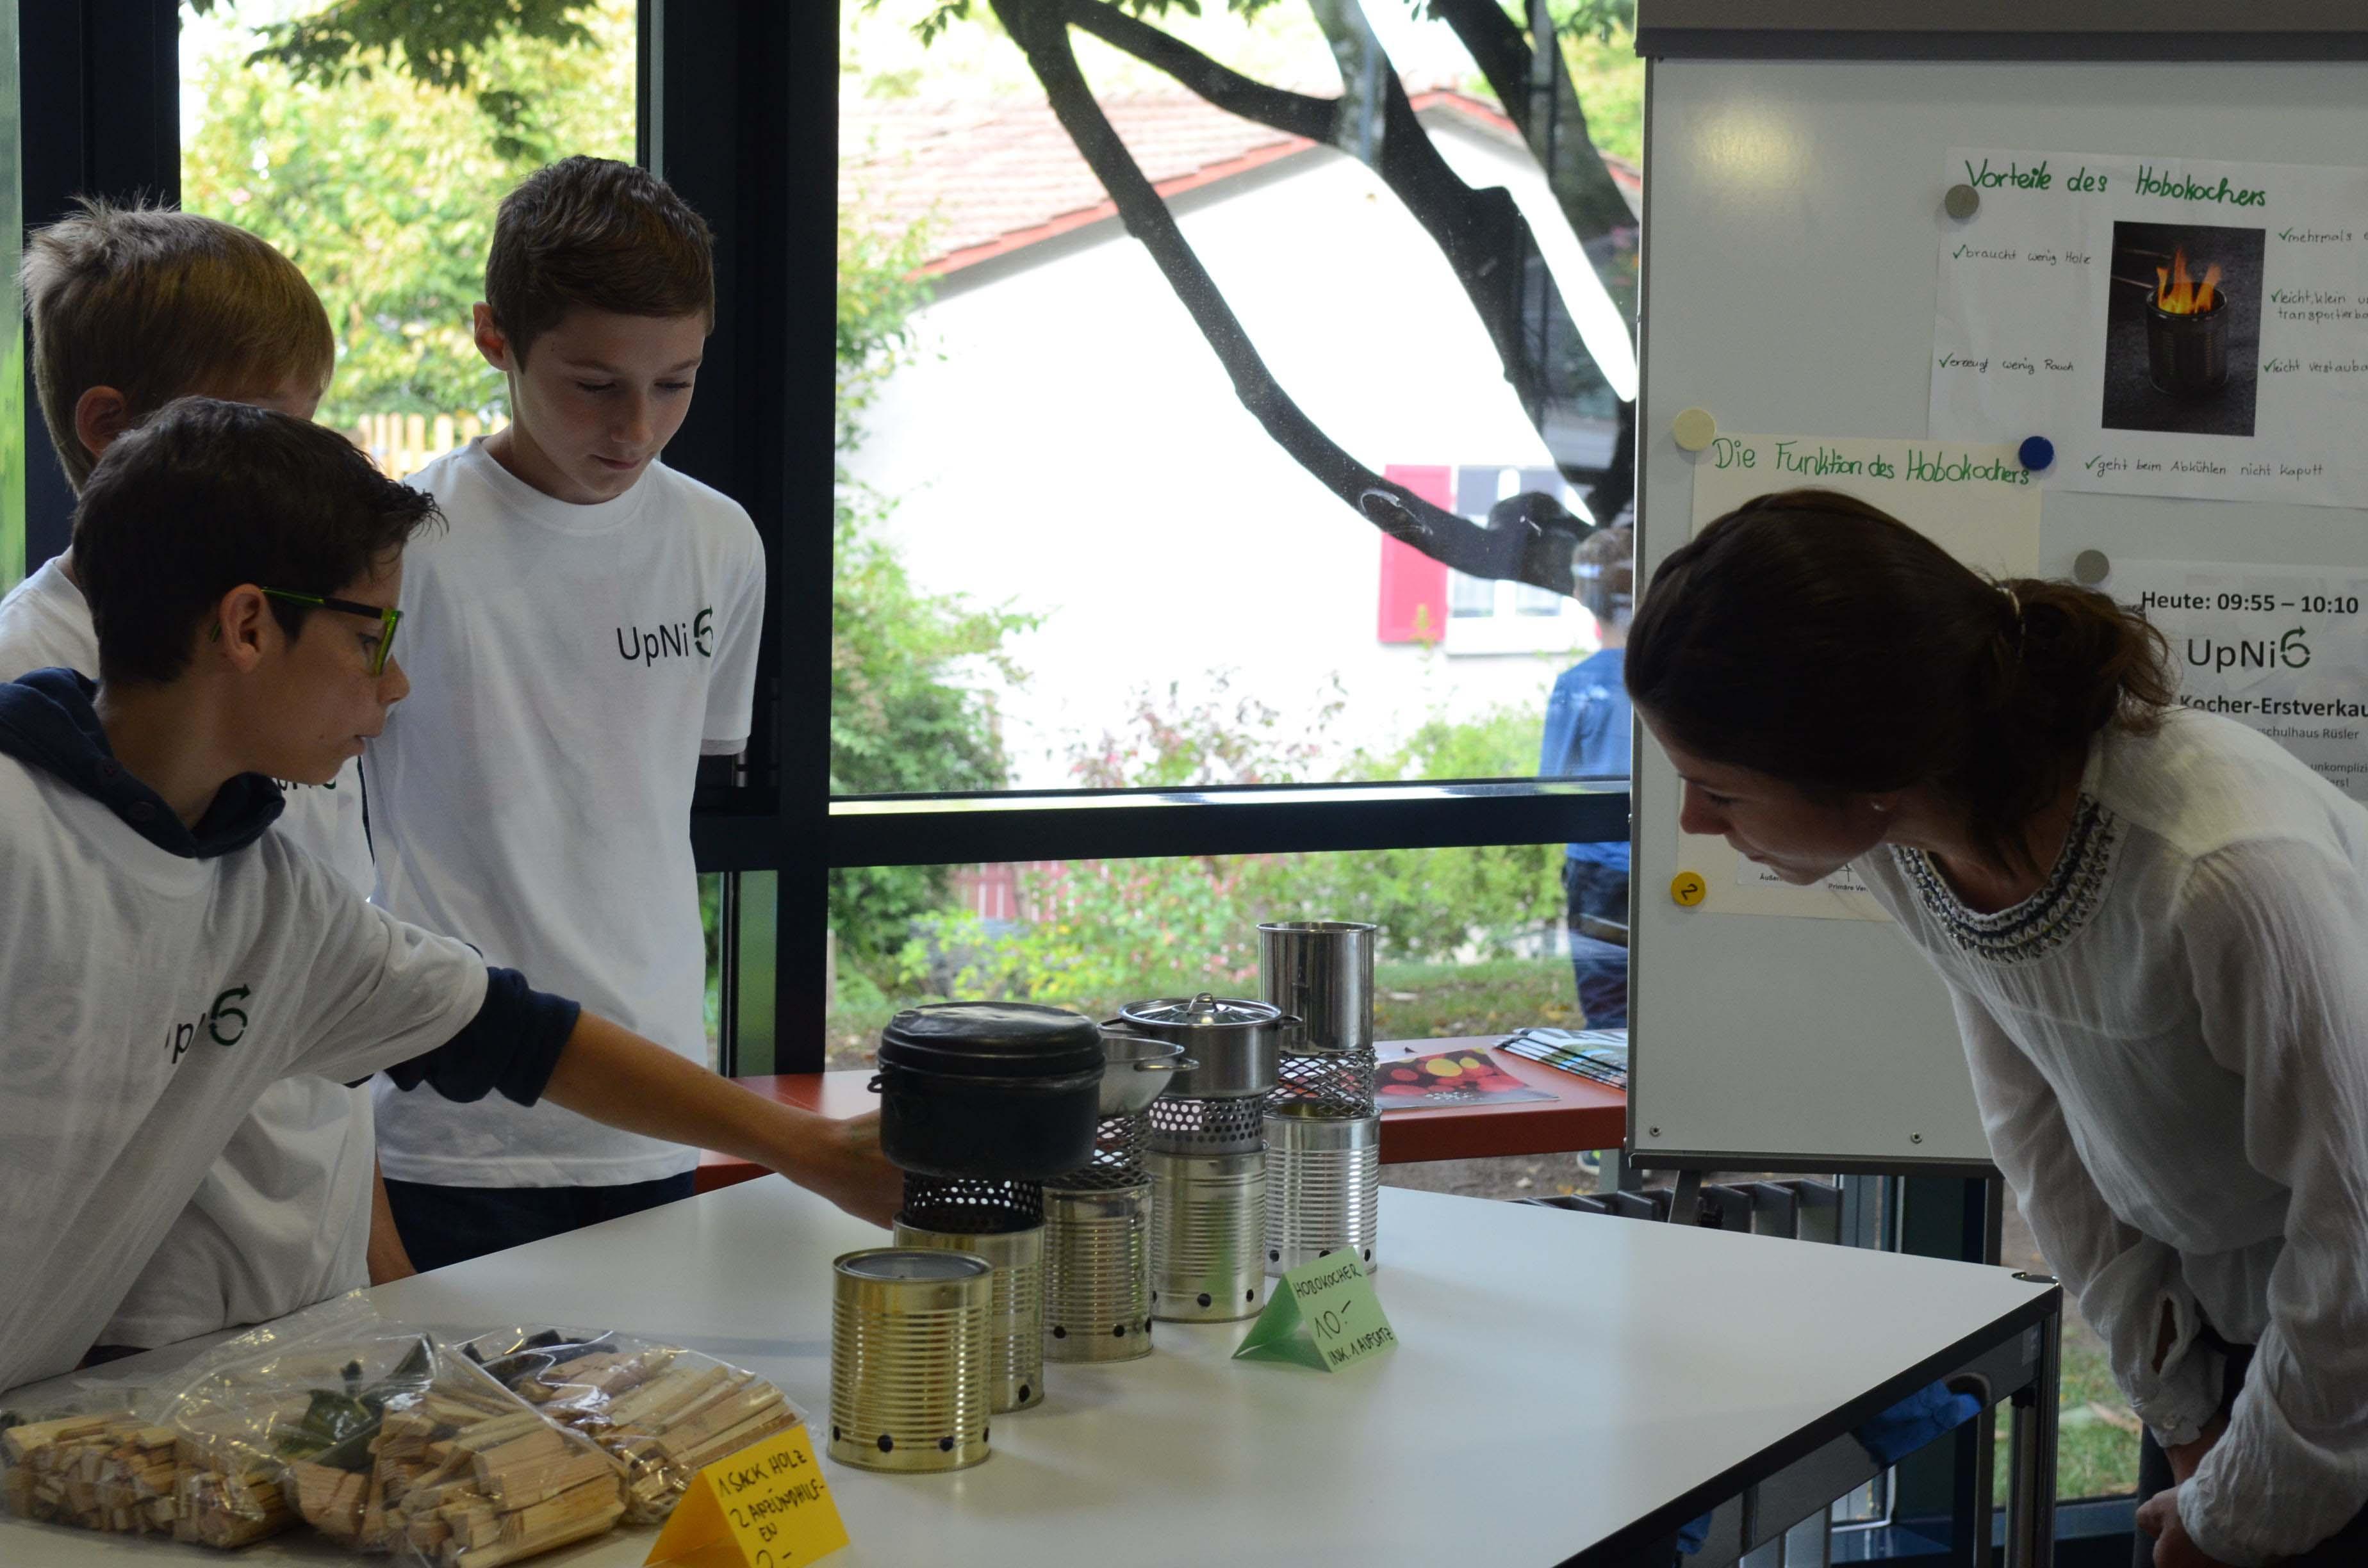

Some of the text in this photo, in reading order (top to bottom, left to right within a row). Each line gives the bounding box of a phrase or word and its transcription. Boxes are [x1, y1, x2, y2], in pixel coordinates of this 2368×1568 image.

[1965, 158, 2266, 206] Vorteile des Hobokochers
[1966, 247, 2091, 266] braucht wenig Holz
[2002, 357, 2034, 375] wenig
[2044, 359, 2074, 372] Rauch
[2273, 359, 2300, 373] leicht
[1712, 437, 2029, 486] Die Funktion des Hobokochers
[2098, 457, 2128, 477] geht
[2136, 459, 2161, 471] beim
[2171, 460, 2226, 475] Abkühlen
[2241, 462, 2271, 475] nicht
[2142, 591, 2210, 610] Heute:
[2217, 593, 2275, 612] 09:55
[2301, 596, 2359, 614] 10:10
[2256, 725, 2360, 740] schulhaus Rüsler
[1292, 1263, 1362, 1298] HOBOKOCHER
[728, 1463, 769, 1493] SACK
[769, 1450, 808, 1474] HOLZ
[729, 1508, 749, 1528] 2
